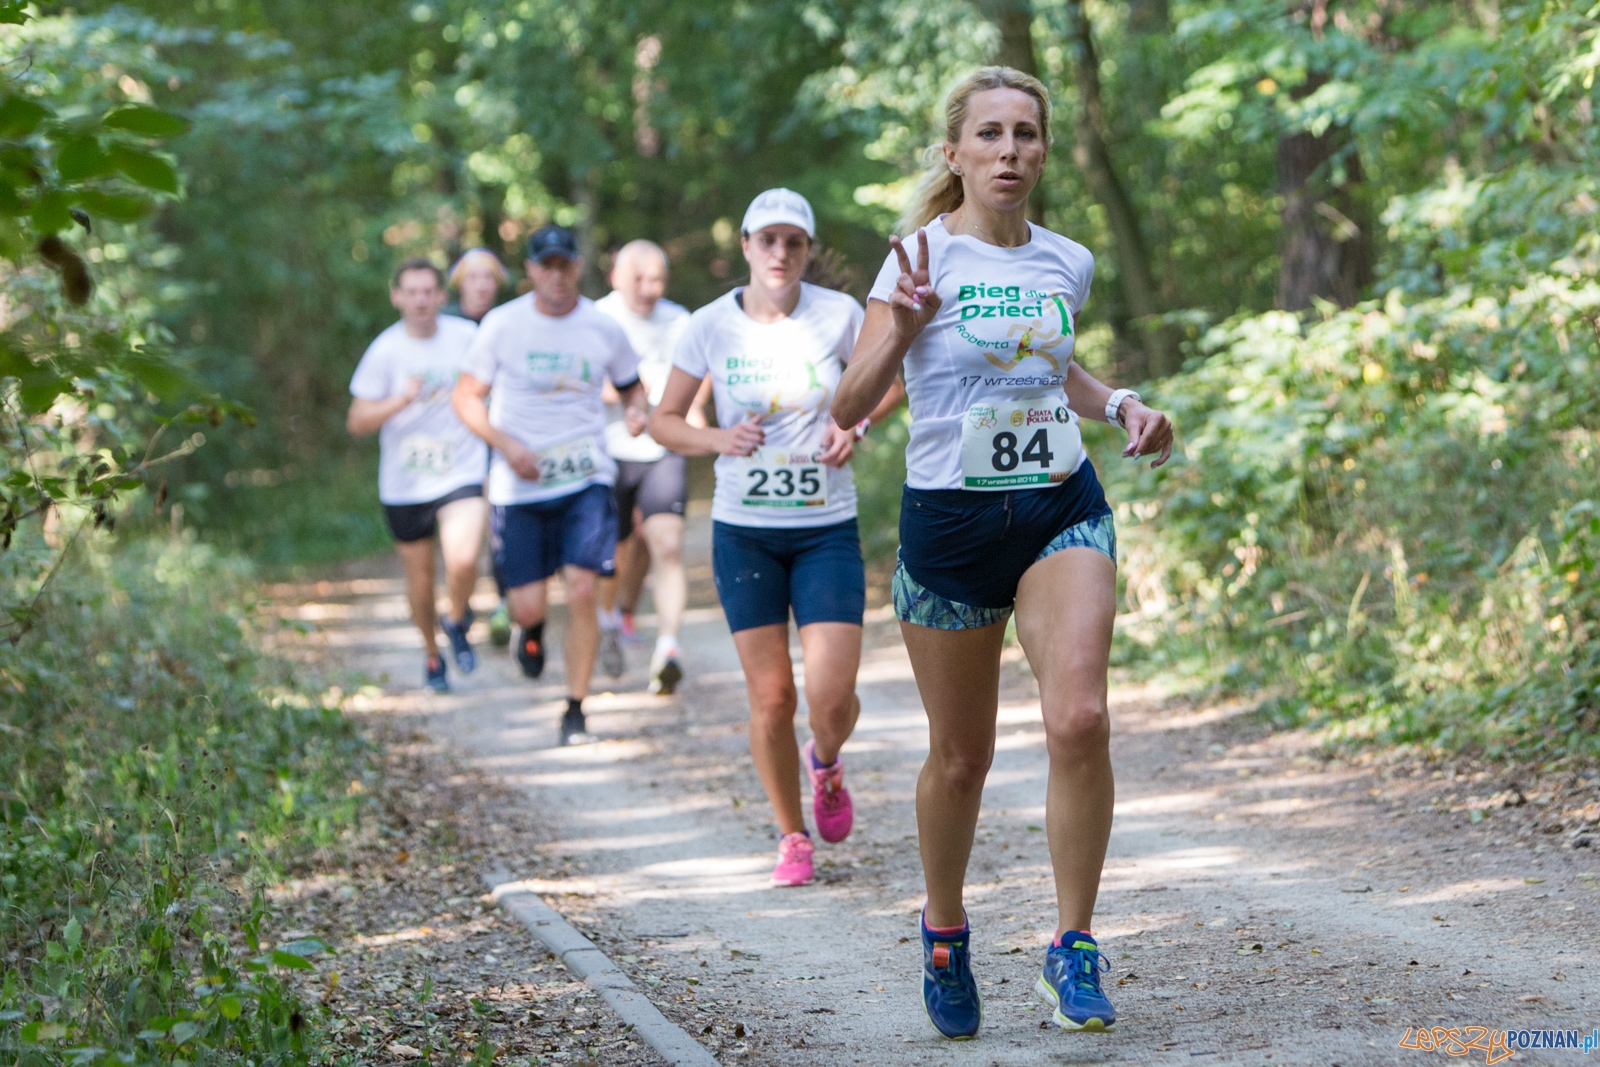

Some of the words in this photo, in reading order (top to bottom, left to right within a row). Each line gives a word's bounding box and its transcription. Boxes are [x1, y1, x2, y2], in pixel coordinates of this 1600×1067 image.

[958, 282, 1021, 302] Bieg
[1025, 289, 1047, 298] dla
[960, 300, 1043, 320] Dzieci
[955, 323, 1009, 349] Roberta
[960, 375, 982, 387] 17
[984, 374, 1049, 386] września
[1026, 416, 1055, 426] POLSKA
[1027, 408, 1052, 417] CHATA
[990, 427, 1054, 472] 84
[747, 466, 820, 496] 235
[976, 478, 988, 486] 17
